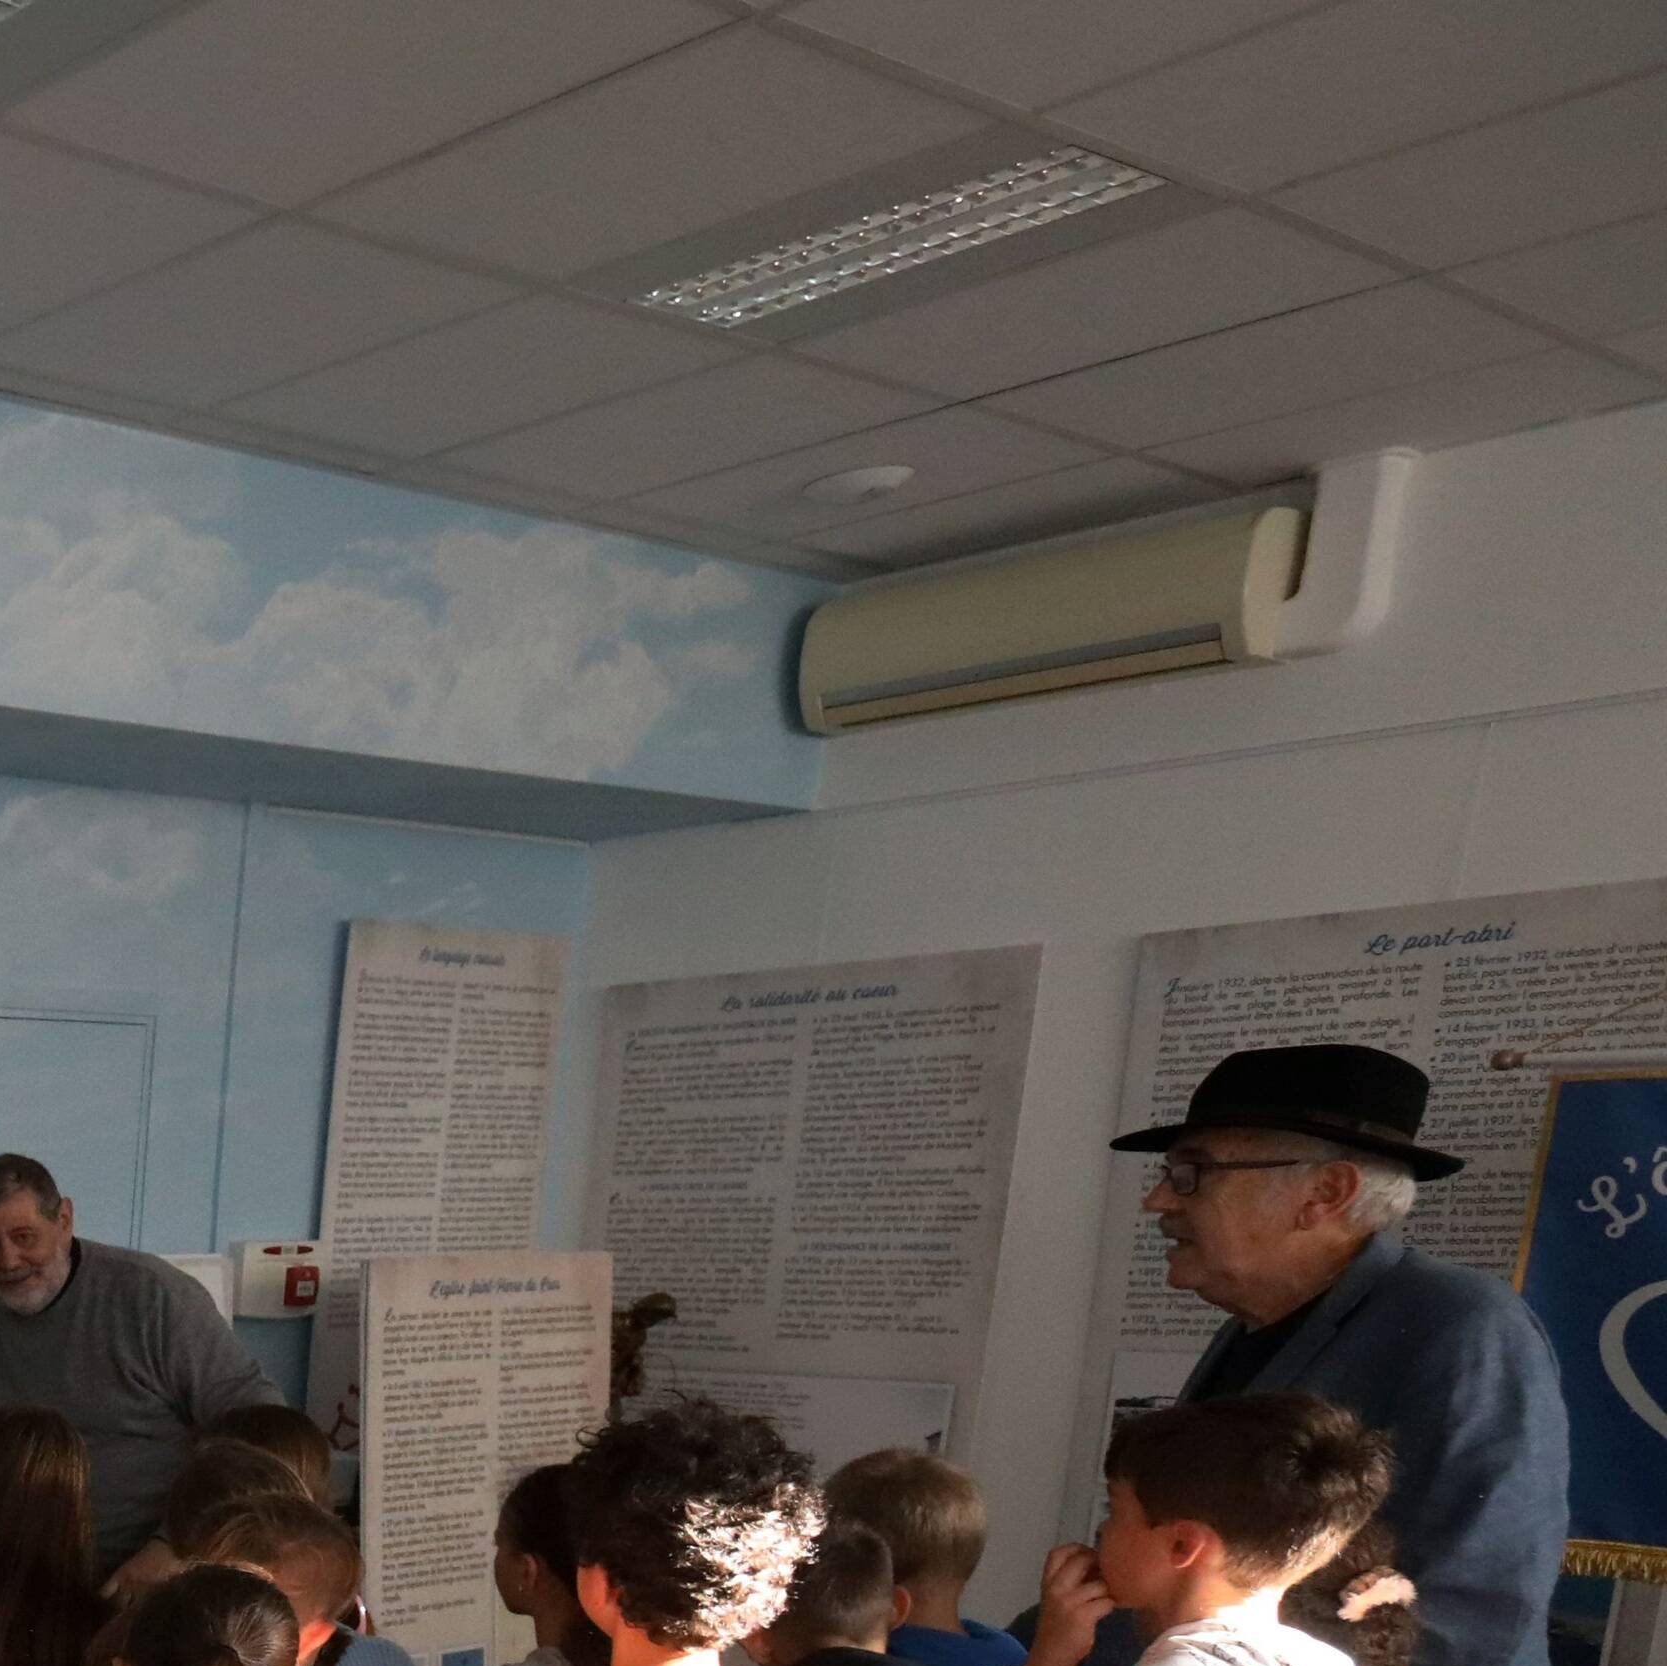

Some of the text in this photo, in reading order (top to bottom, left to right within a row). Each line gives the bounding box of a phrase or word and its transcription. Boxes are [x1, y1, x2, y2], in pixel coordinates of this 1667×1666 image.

[1364, 921, 1516, 956] Le port-abri
[750, 986, 819, 1009] solidarité
